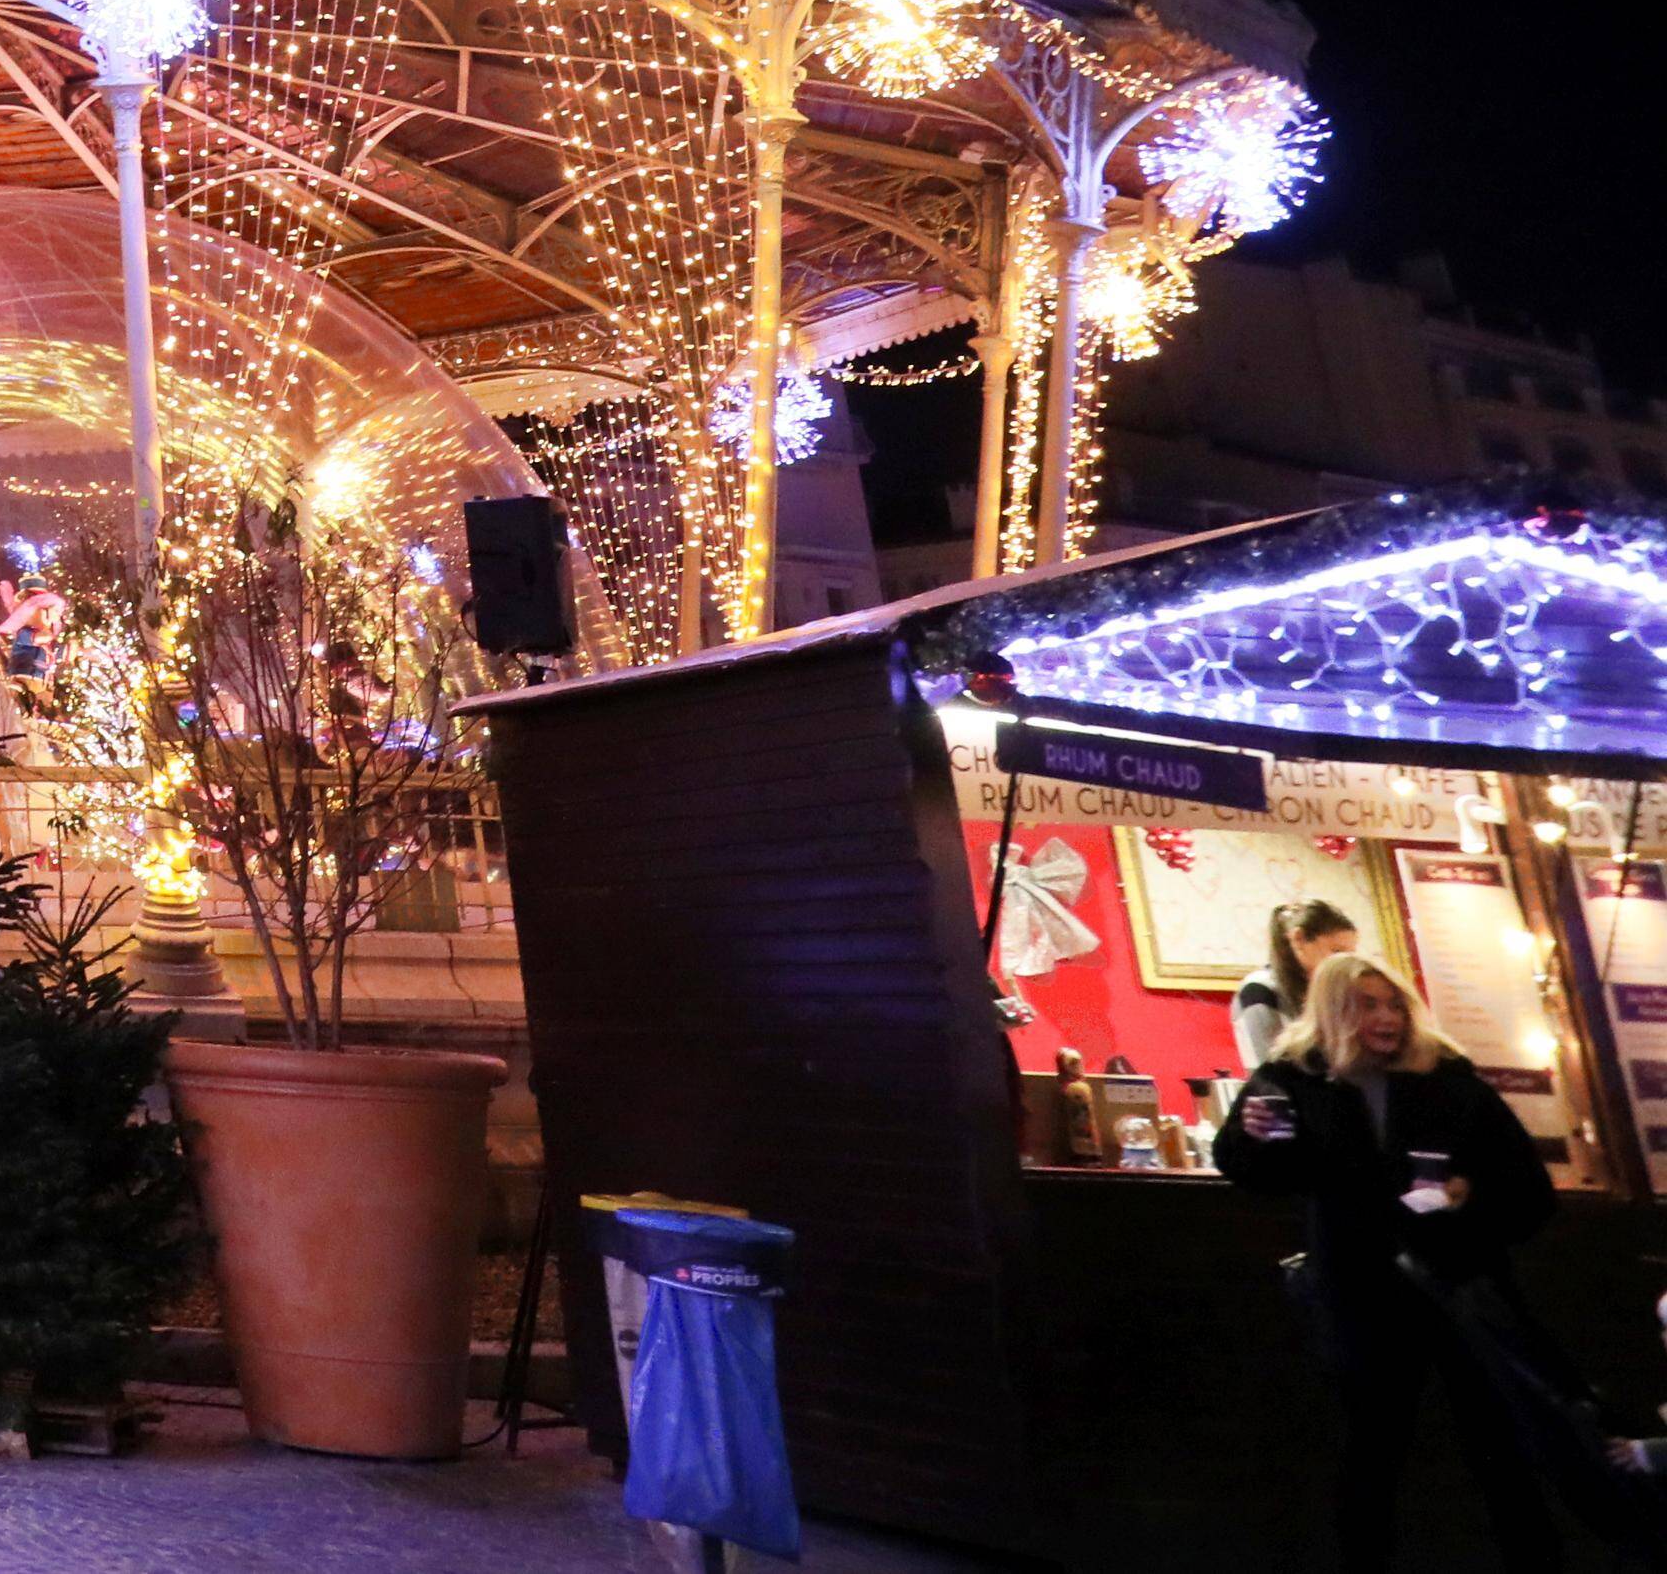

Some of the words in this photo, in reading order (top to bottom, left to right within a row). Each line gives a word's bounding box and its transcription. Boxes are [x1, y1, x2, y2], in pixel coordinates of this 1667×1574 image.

[1044, 743, 1107, 775] RHUM
[1117, 755, 1203, 791] CHAUD
[1270, 764, 1346, 788] ALIEN
[980, 782, 1063, 814] RHUM
[1076, 787, 1176, 819] CHAUD
[1336, 798, 1436, 830] CHAUD
[691, 1270, 760, 1287] PROPRES
